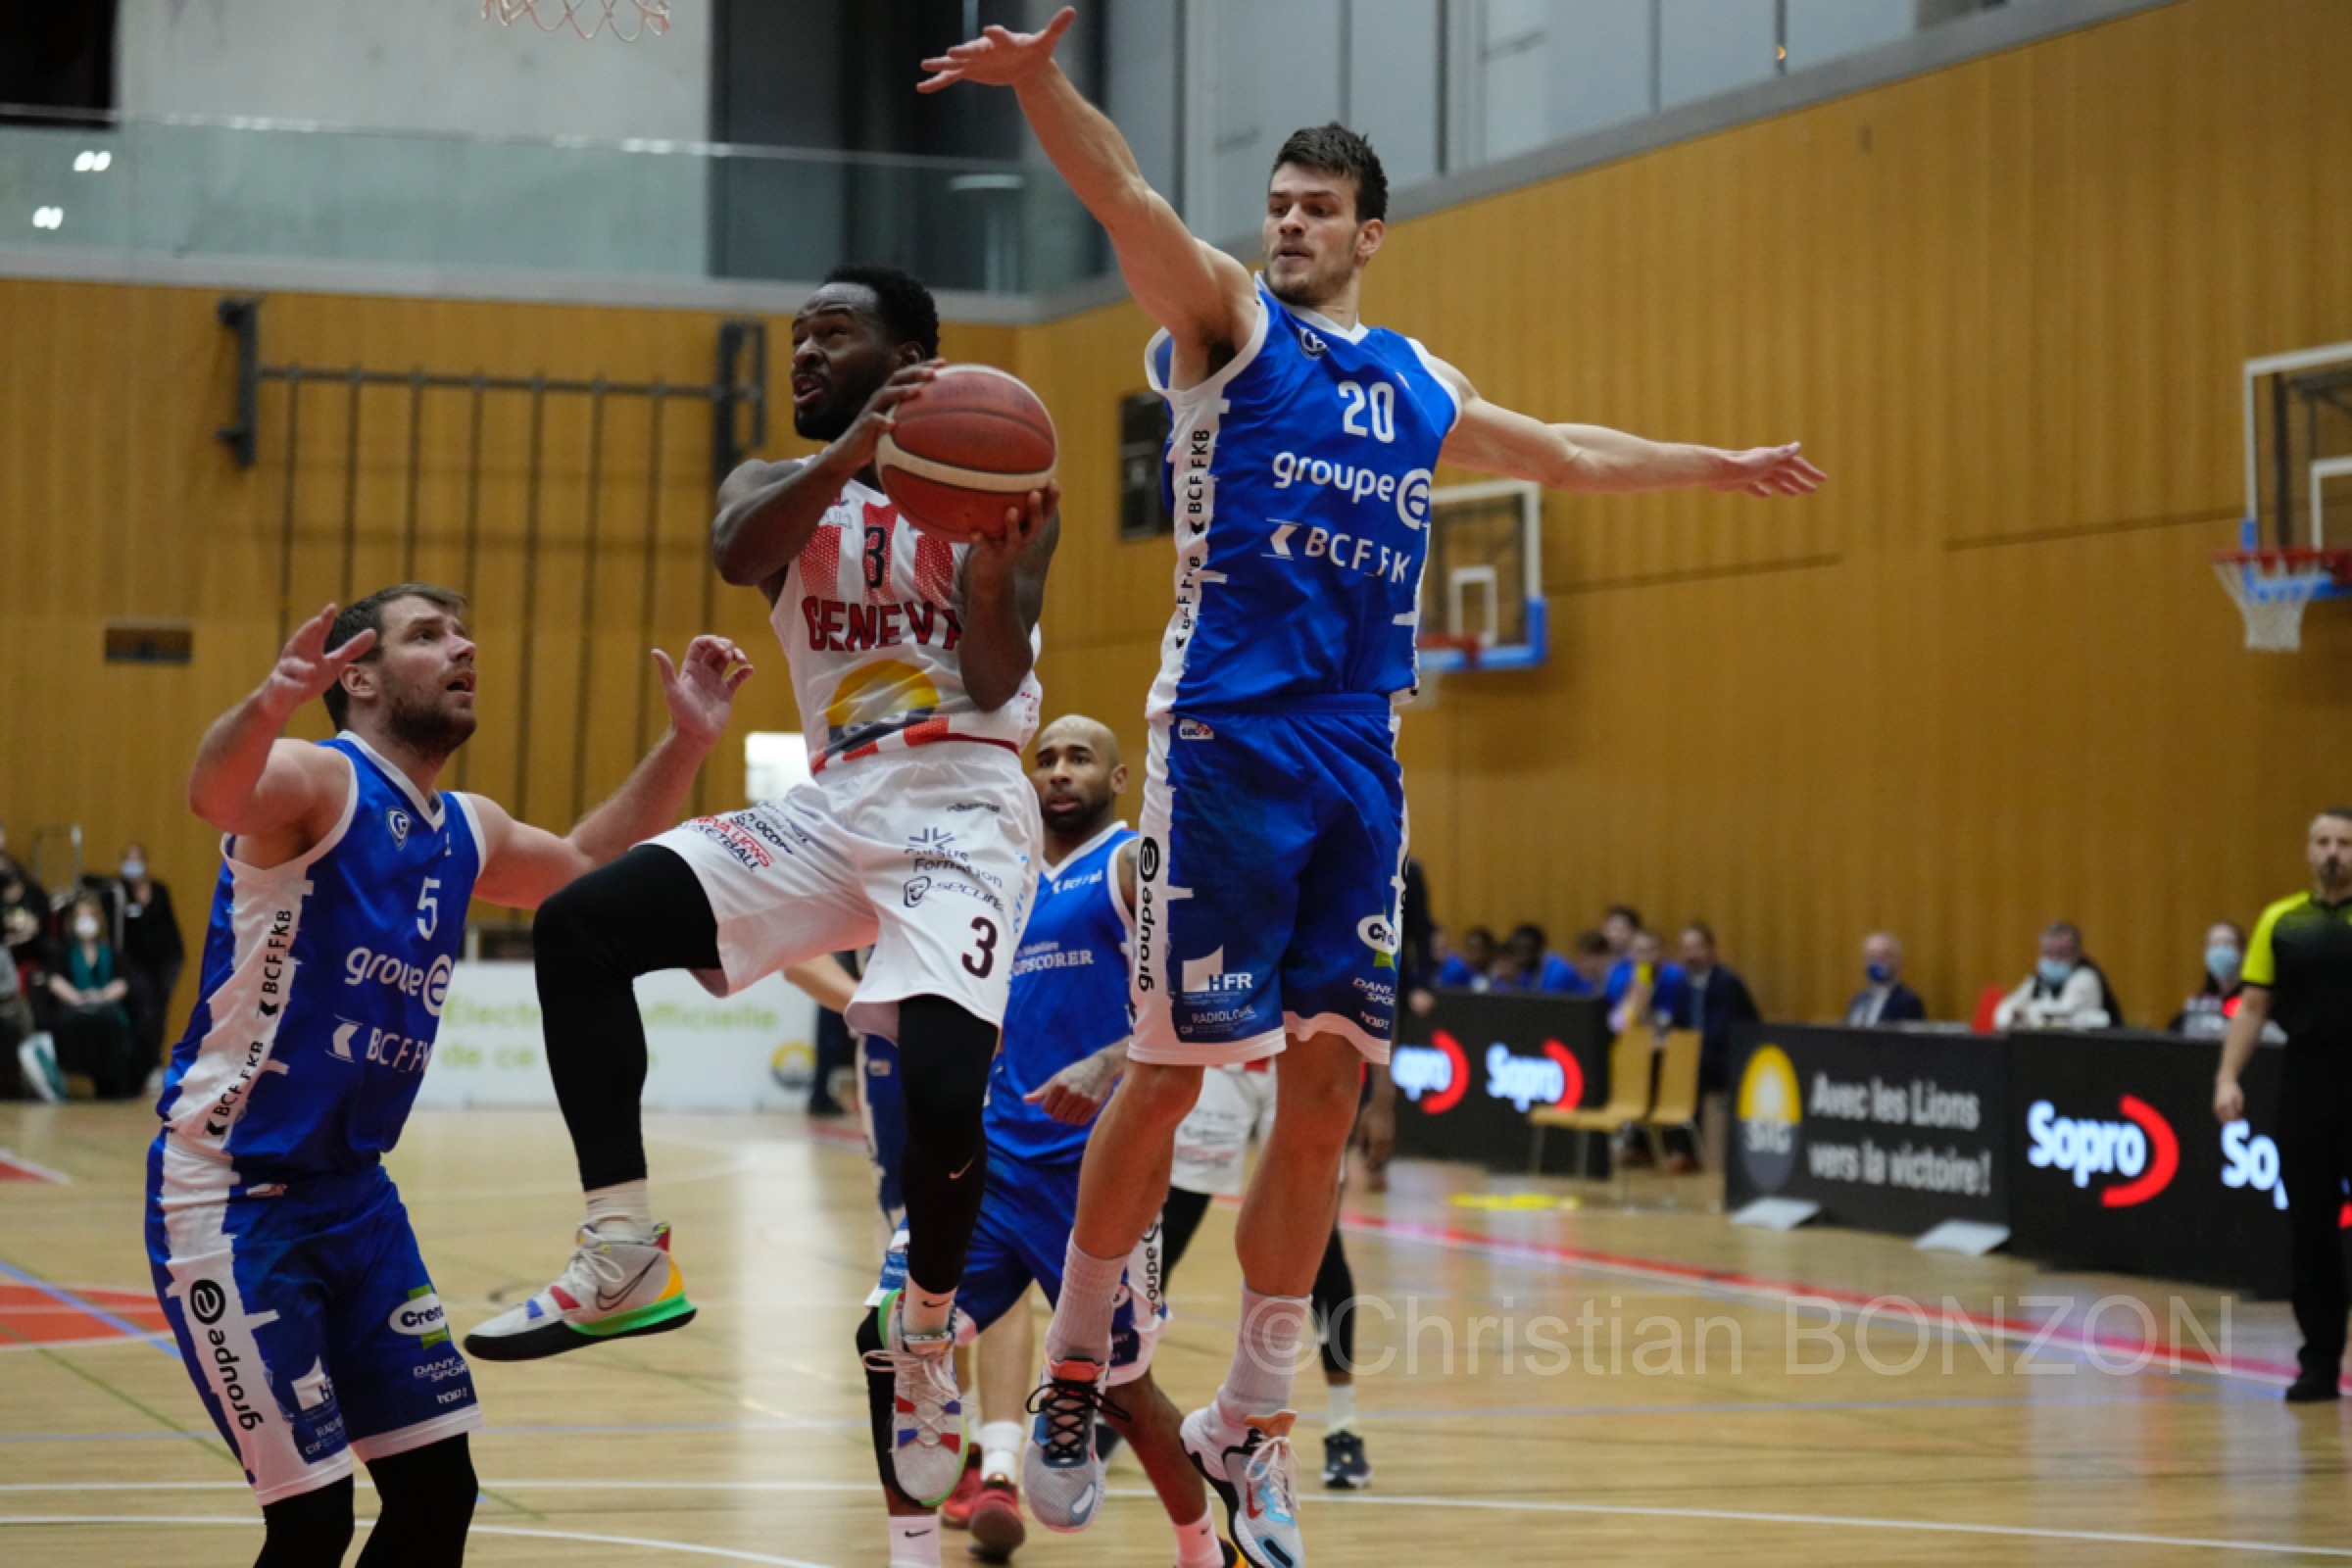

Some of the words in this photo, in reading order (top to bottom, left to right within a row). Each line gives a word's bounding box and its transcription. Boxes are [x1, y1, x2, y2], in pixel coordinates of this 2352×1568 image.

[1338, 380, 1396, 444] 20
[1273, 451, 1396, 505] groupe
[863, 525, 887, 589] 3
[416, 877, 440, 941] 5
[1138, 886, 1155, 992] groupe
[961, 916, 999, 979] 3
[1012, 949, 1095, 976] OPSCORER
[1810, 1070, 1868, 1121] Avec
[1870, 1075, 1908, 1124] les
[1911, 1078, 1981, 1131] Lions
[1808, 1142, 1858, 1183] vers
[1863, 1138, 1886, 1185] la
[2027, 1099, 2147, 1189] Sopro
[207, 1328, 265, 1432] groupe
